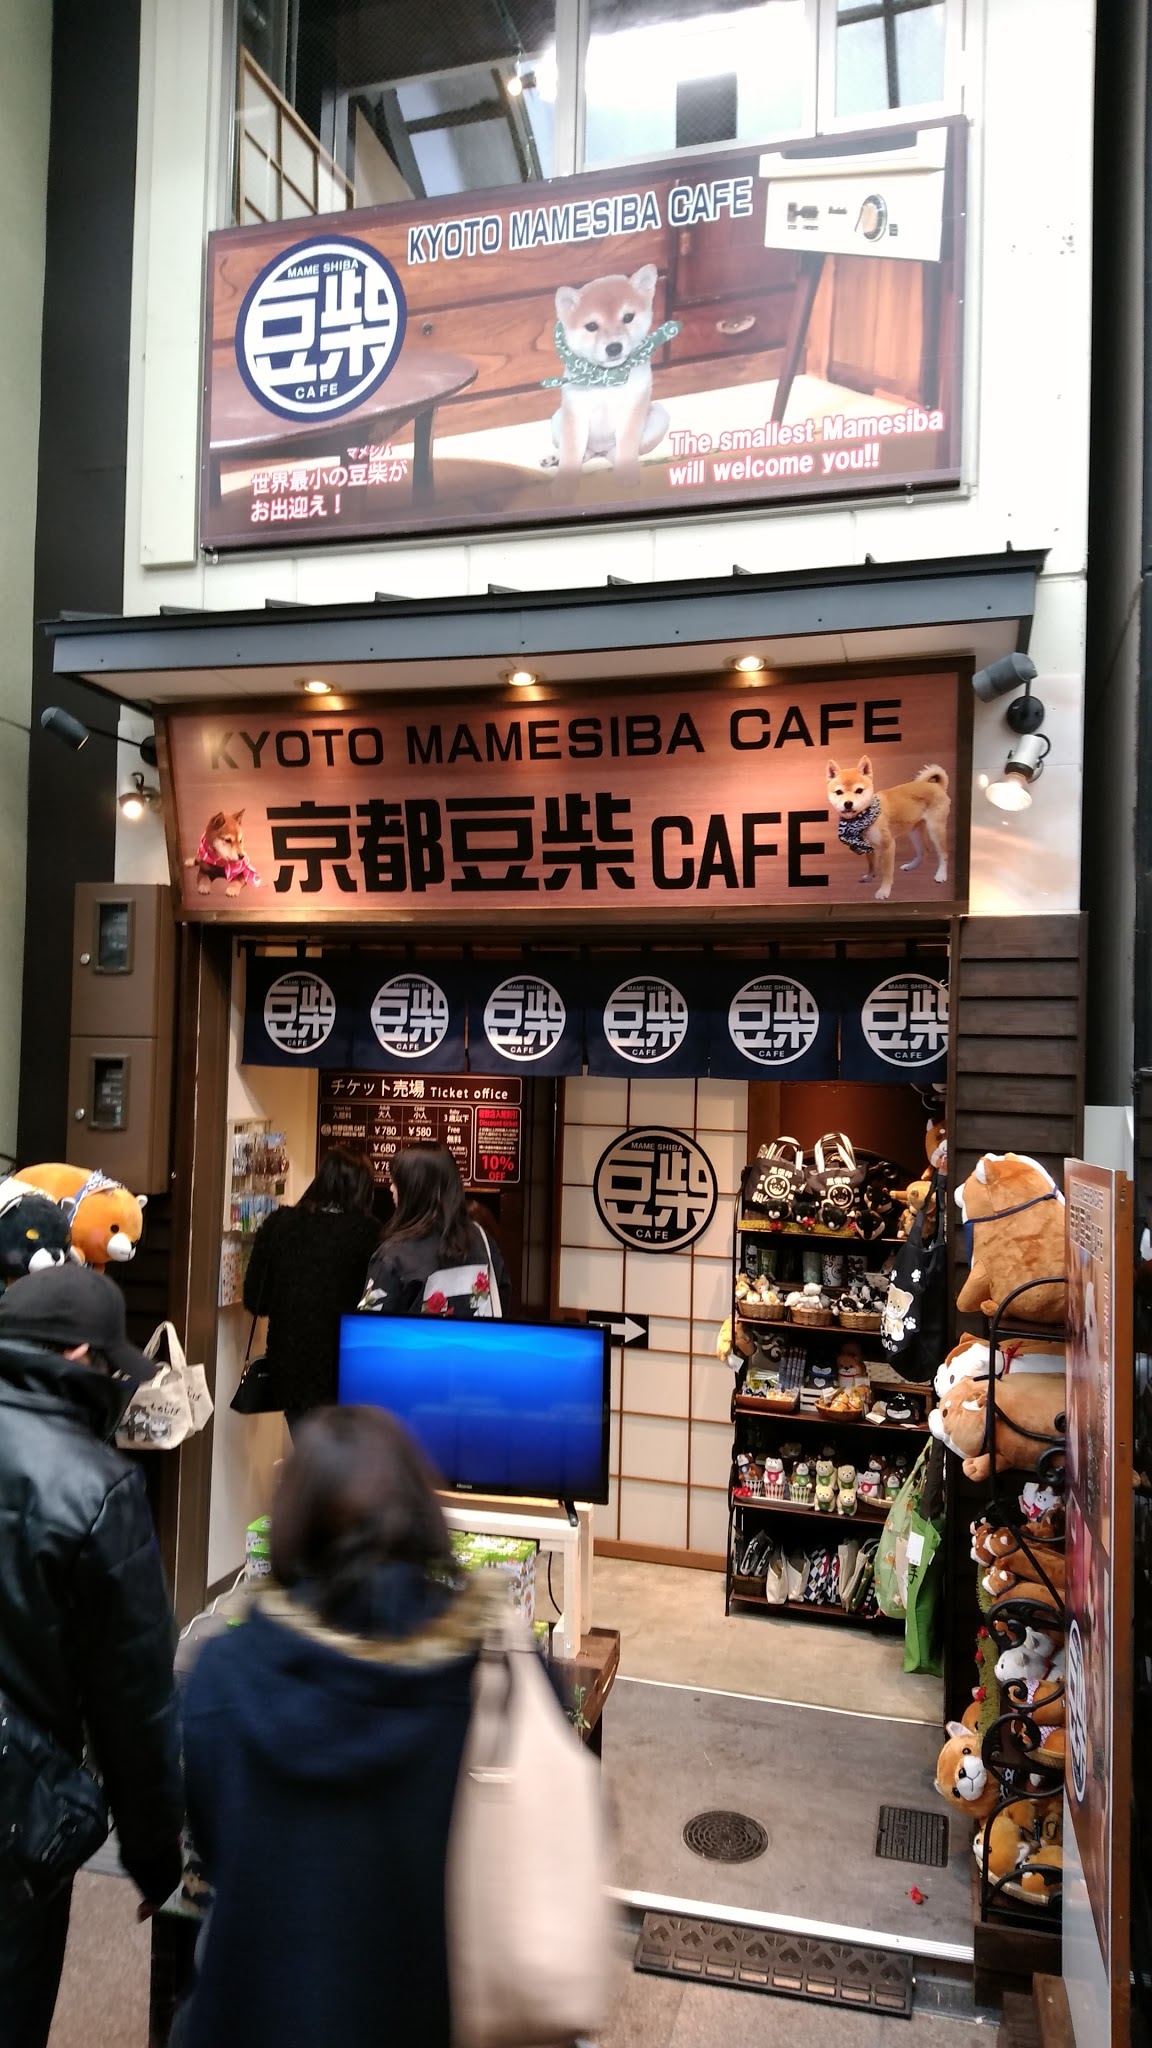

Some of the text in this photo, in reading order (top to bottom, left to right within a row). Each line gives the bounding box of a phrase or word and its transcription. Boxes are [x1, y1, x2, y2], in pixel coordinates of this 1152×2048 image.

[409, 177, 753, 264] KYOTO MAMESIBA CAFE
[287, 259, 359, 279] MAME SHIBA
[245, 268, 397, 386] 豆柴
[295, 382, 338, 399] CAFE
[669, 409, 944, 456] The smallest Mamesiba
[346, 443, 393, 460] マメシバ
[668, 442, 880, 486] will welcome you!!
[251, 461, 408, 496] 世界最小の豆柴が
[208, 698, 903, 770] KYOTO MAMESIBA CAFE
[266, 792, 830, 894] 京都豆柴 CAFE
[265, 986, 334, 1039] 豆柴
[372, 988, 448, 1042] 豆柴
[484, 990, 565, 1046] 豆柴
[604, 991, 688, 1047] 豆柴
[729, 990, 819, 1048] 豆柴
[287, 1039, 307, 1047] CAFE
[396, 1043, 419, 1051] CAFE
[510, 1046, 534, 1054] CAFE
[894, 1051, 922, 1059] CAFE
[331, 1078, 508, 1100] チケット売場 Ticket office
[413, 1111, 427, 1120] 小人
[447, 1126, 460, 1134] Free
[631, 1141, 684, 1152] MAME SHIBA
[481, 1154, 514, 1171] 10%
[488, 1172, 506, 1182] OFF
[599, 1150, 714, 1229] 豆柴
[636, 1229, 669, 1240] CAFE
